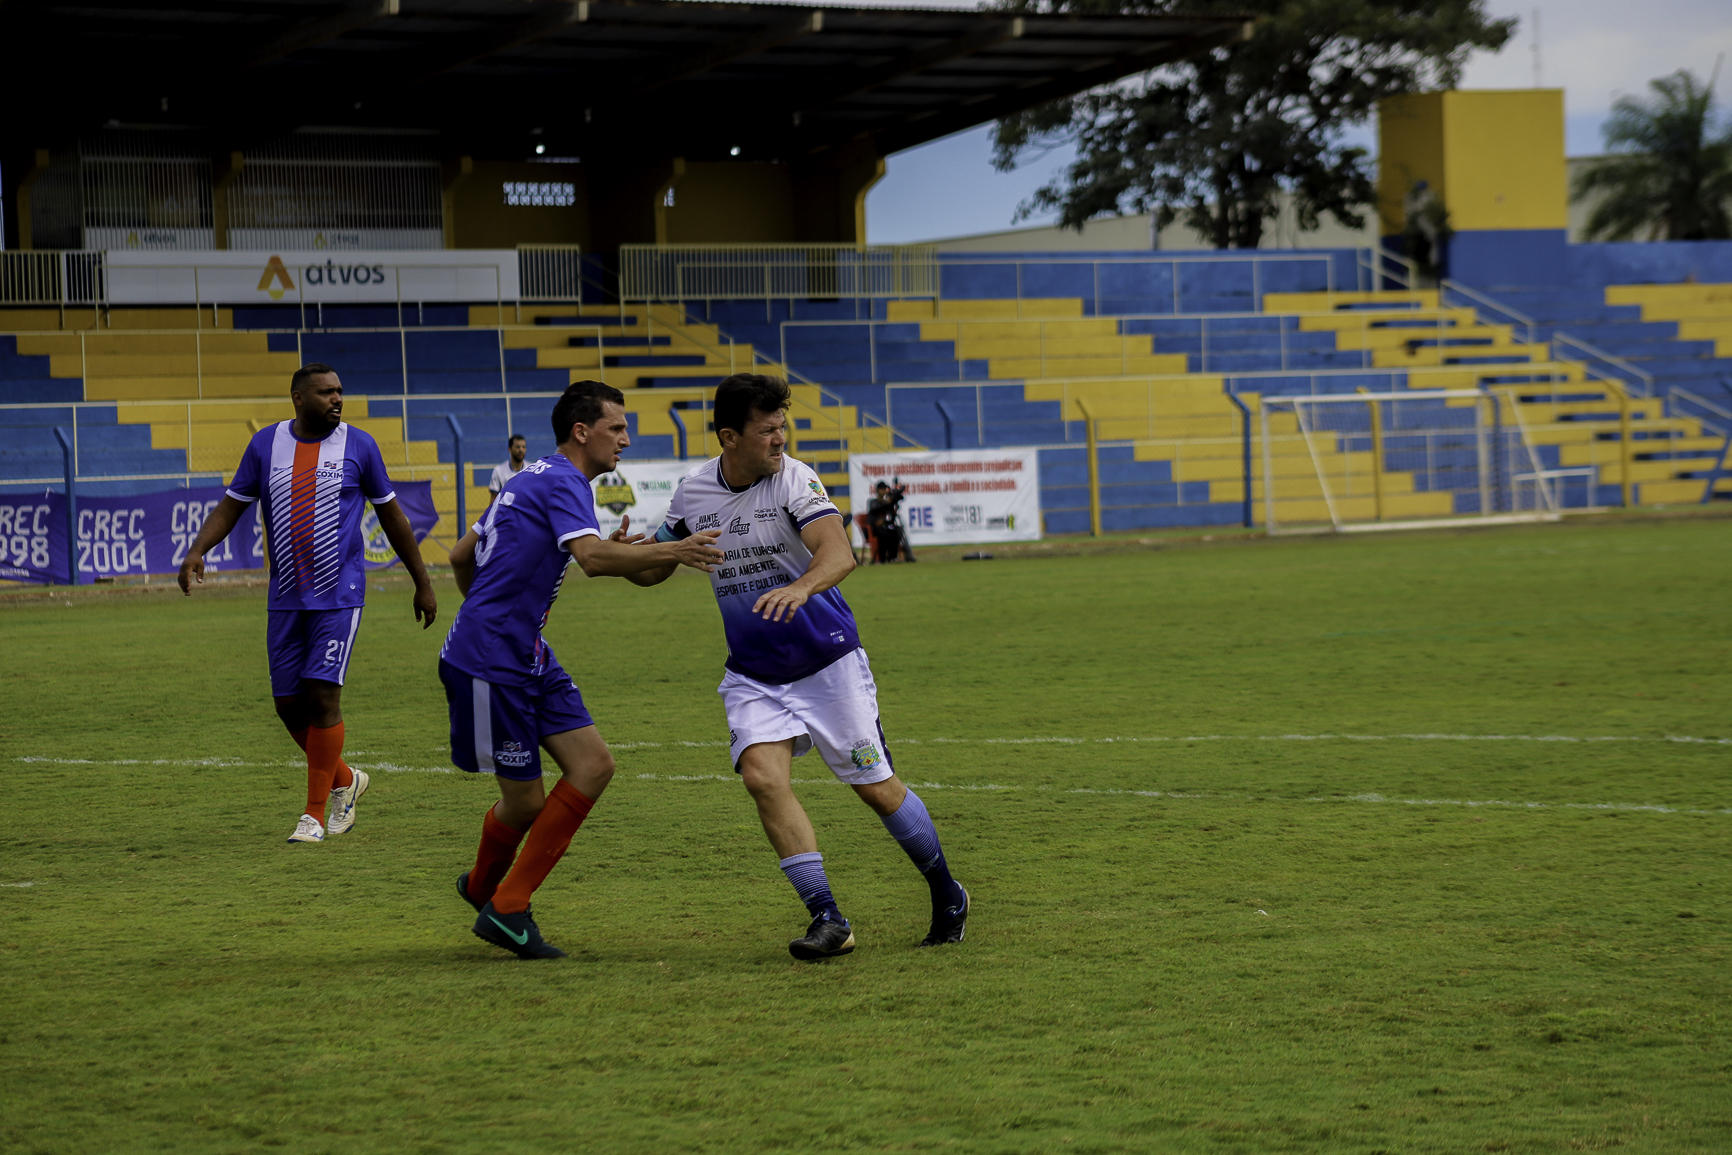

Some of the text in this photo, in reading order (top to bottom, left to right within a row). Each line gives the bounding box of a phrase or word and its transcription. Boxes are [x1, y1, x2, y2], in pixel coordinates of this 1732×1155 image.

[305, 257, 385, 285] atvos
[315, 470, 343, 480] COXIM
[77, 508, 146, 541] CREC
[171, 500, 219, 533] CRE
[908, 506, 933, 528] FIE
[76, 539, 147, 573] 2004
[742, 547, 751, 559] DE
[717, 559, 779, 580] MEIO AMBIENTE,
[717, 573, 791, 598] ESPORTE E CULTURA
[325, 639, 345, 662] 21
[495, 752, 531, 764] COXIM
